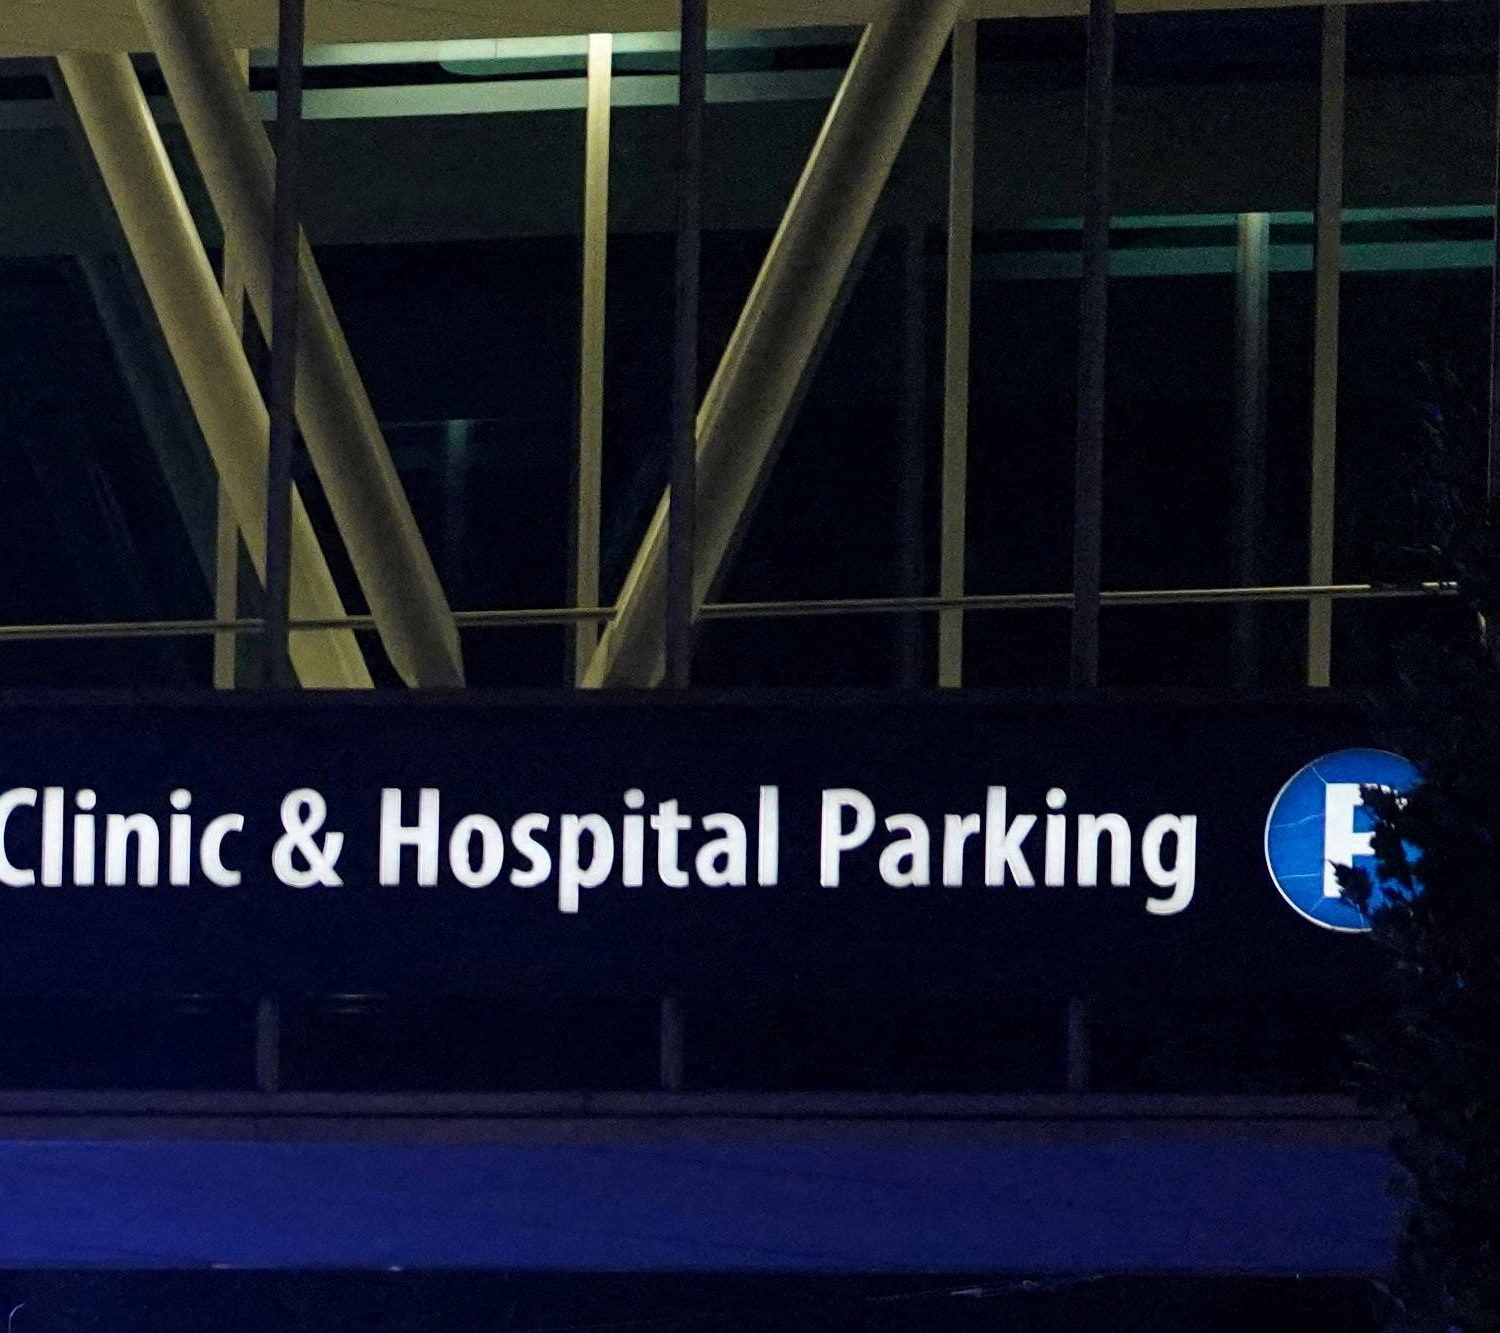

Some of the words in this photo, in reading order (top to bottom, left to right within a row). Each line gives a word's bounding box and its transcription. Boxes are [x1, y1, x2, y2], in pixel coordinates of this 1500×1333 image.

[271, 787, 345, 891] &
[380, 784, 781, 914] Hospital
[820, 784, 1198, 916] Parking
